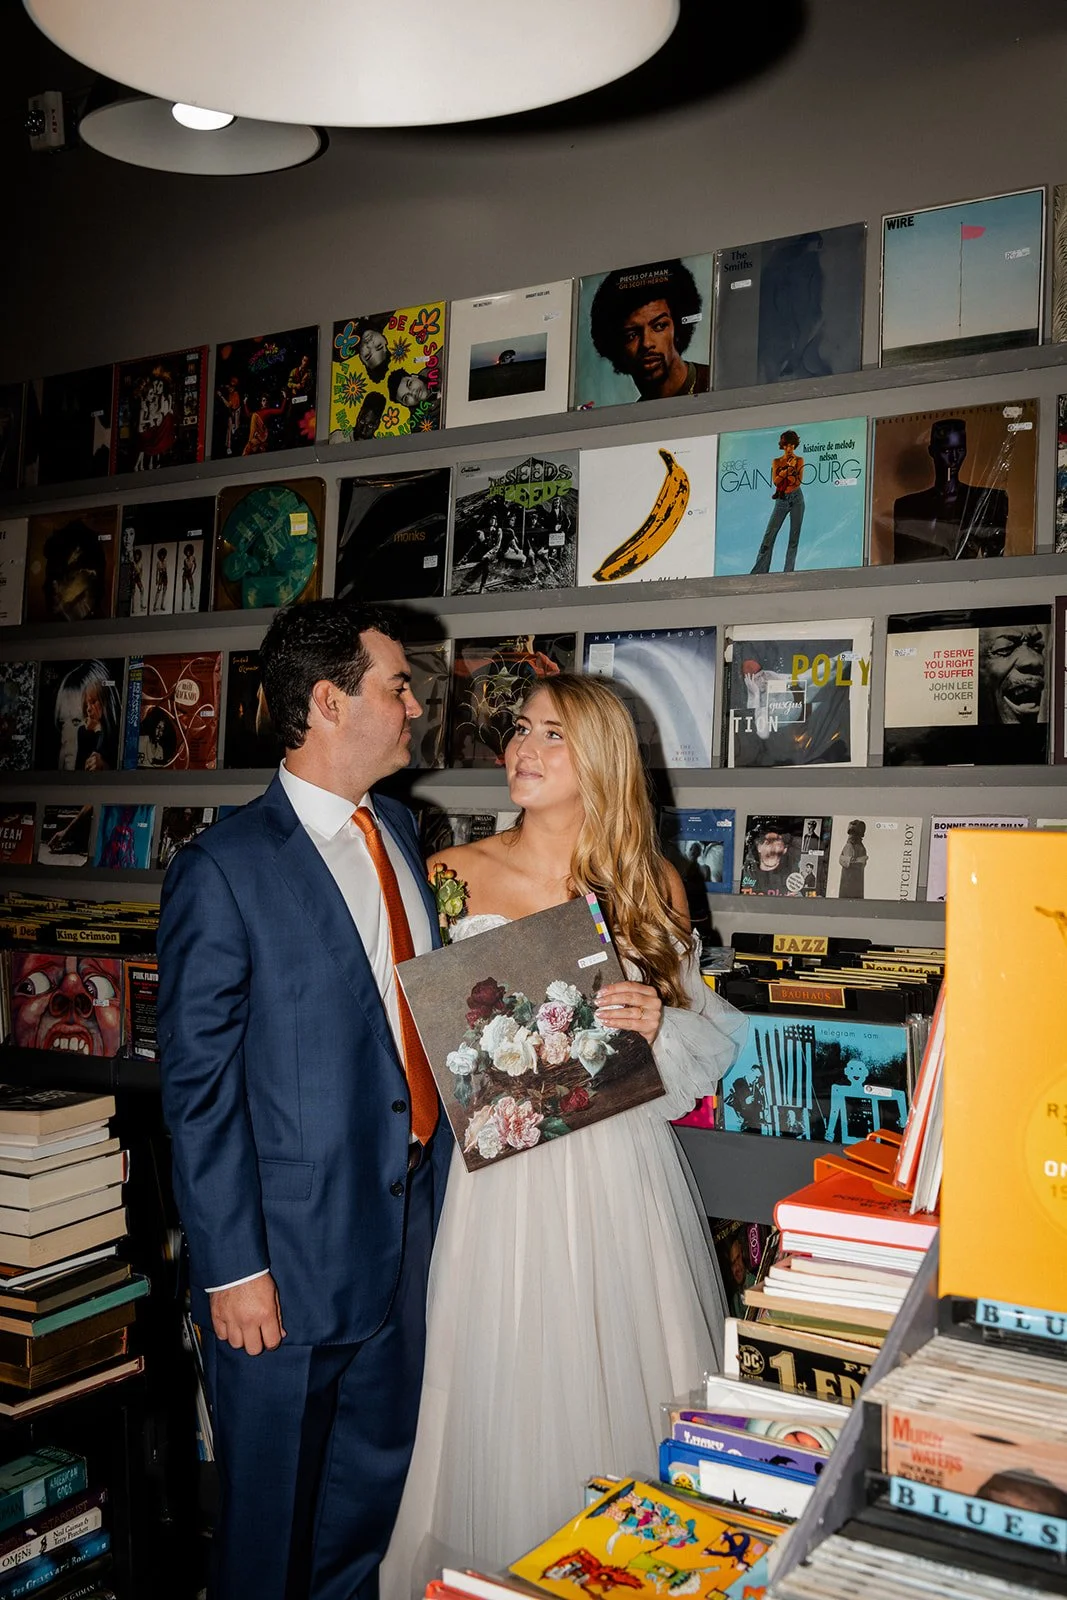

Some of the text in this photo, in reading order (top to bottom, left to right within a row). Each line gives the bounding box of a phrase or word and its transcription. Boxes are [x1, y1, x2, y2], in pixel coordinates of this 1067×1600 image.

[887, 216, 914, 231] WIRE
[731, 250, 747, 260] The
[724, 260, 753, 272] Smiths
[388, 315, 407, 331] DE
[423, 341, 439, 390] SOUL
[803, 439, 856, 453] histoire de melody
[488, 457, 573, 487] THE SEEDS
[721, 459, 748, 473] SERGE
[392, 530, 426, 543] monks
[594, 632, 656, 641] HAROLD
[933, 649, 974, 659] IT SERVE
[791, 653, 869, 687] POLY
[925, 659, 974, 669] YOU RIGHT
[924, 669, 974, 679] TO SUFFER
[929, 681, 974, 691] JOHN LEE
[933, 692, 974, 701] HOOKER
[904, 824, 915, 847] BOY
[57, 930, 117, 942] King Crimson
[774, 938, 826, 954] JAZZ
[781, 990, 831, 1001] BAUHAUS
[821, 1028, 856, 1038] telegram
[982, 1302, 1067, 1335] BLU
[743, 1351, 760, 1369] DC
[897, 1483, 1060, 1545] BLUES
[2, 1547, 31, 1568] OMENS
